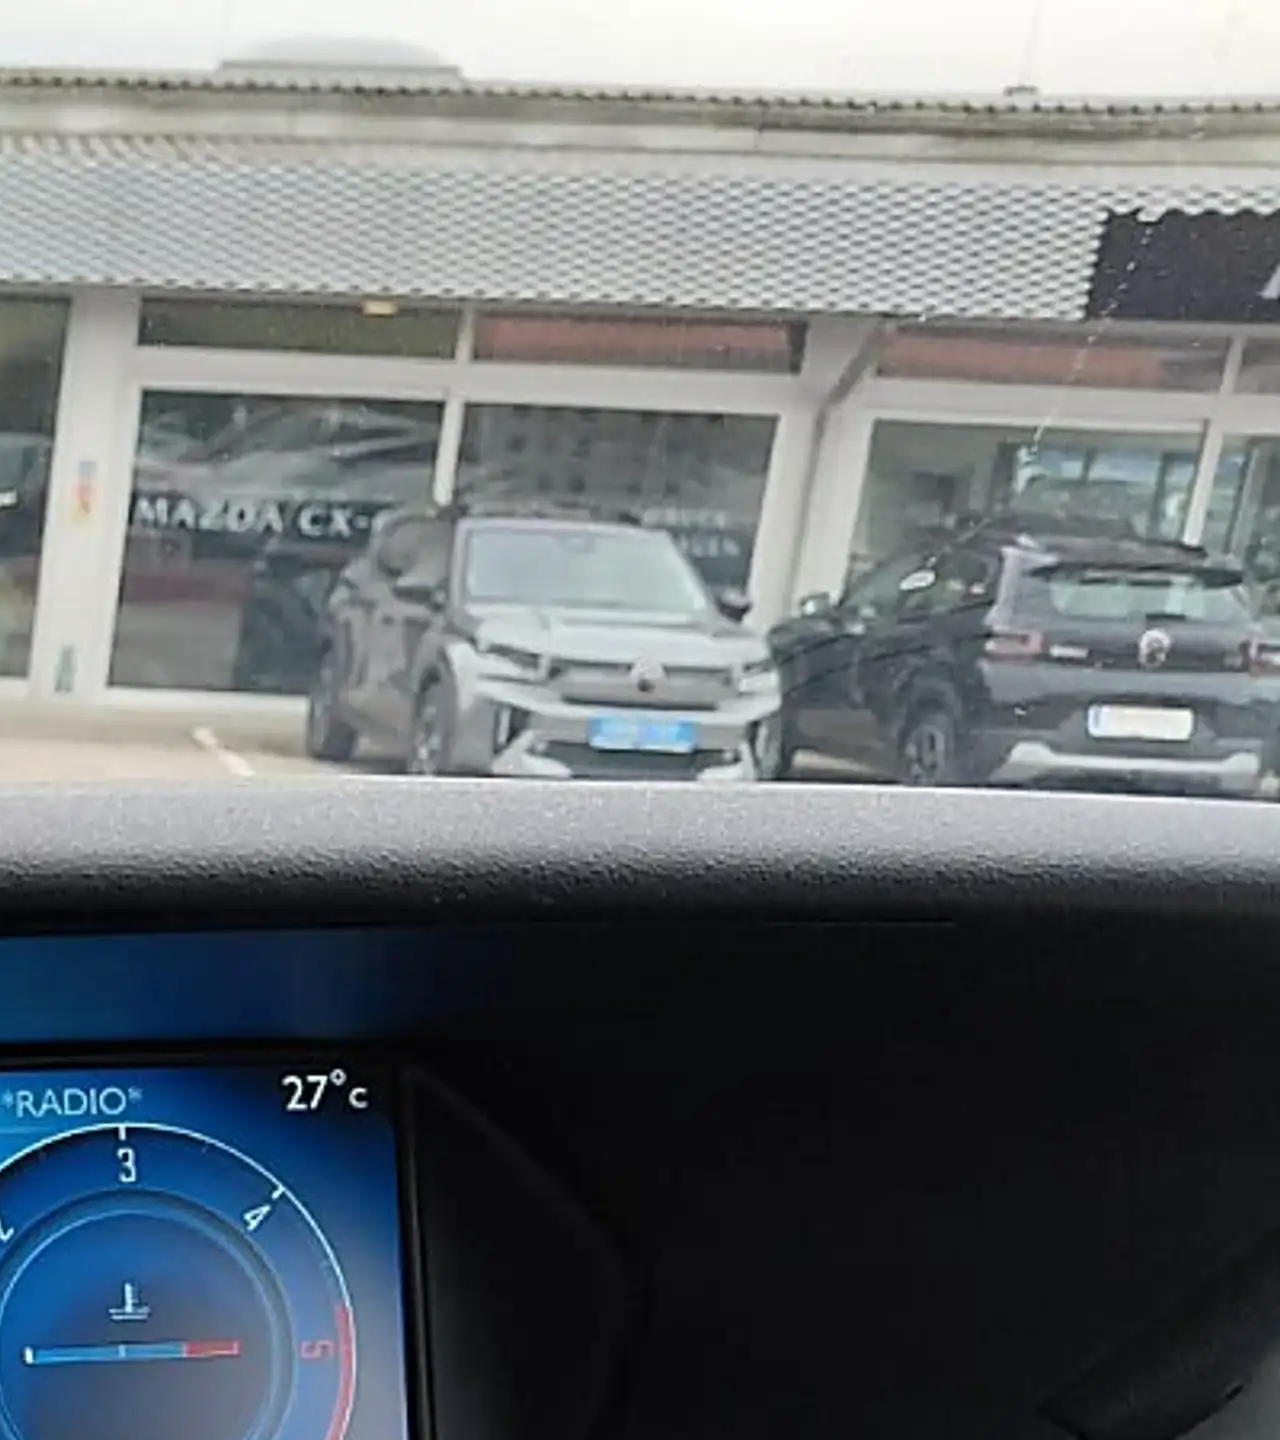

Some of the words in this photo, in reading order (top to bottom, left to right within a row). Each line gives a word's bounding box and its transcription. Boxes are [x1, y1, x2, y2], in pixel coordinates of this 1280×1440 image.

[135, 498, 283, 533] MAZDA
[116, 1147, 137, 1183] 3
[243, 1204, 271, 1232] 4
